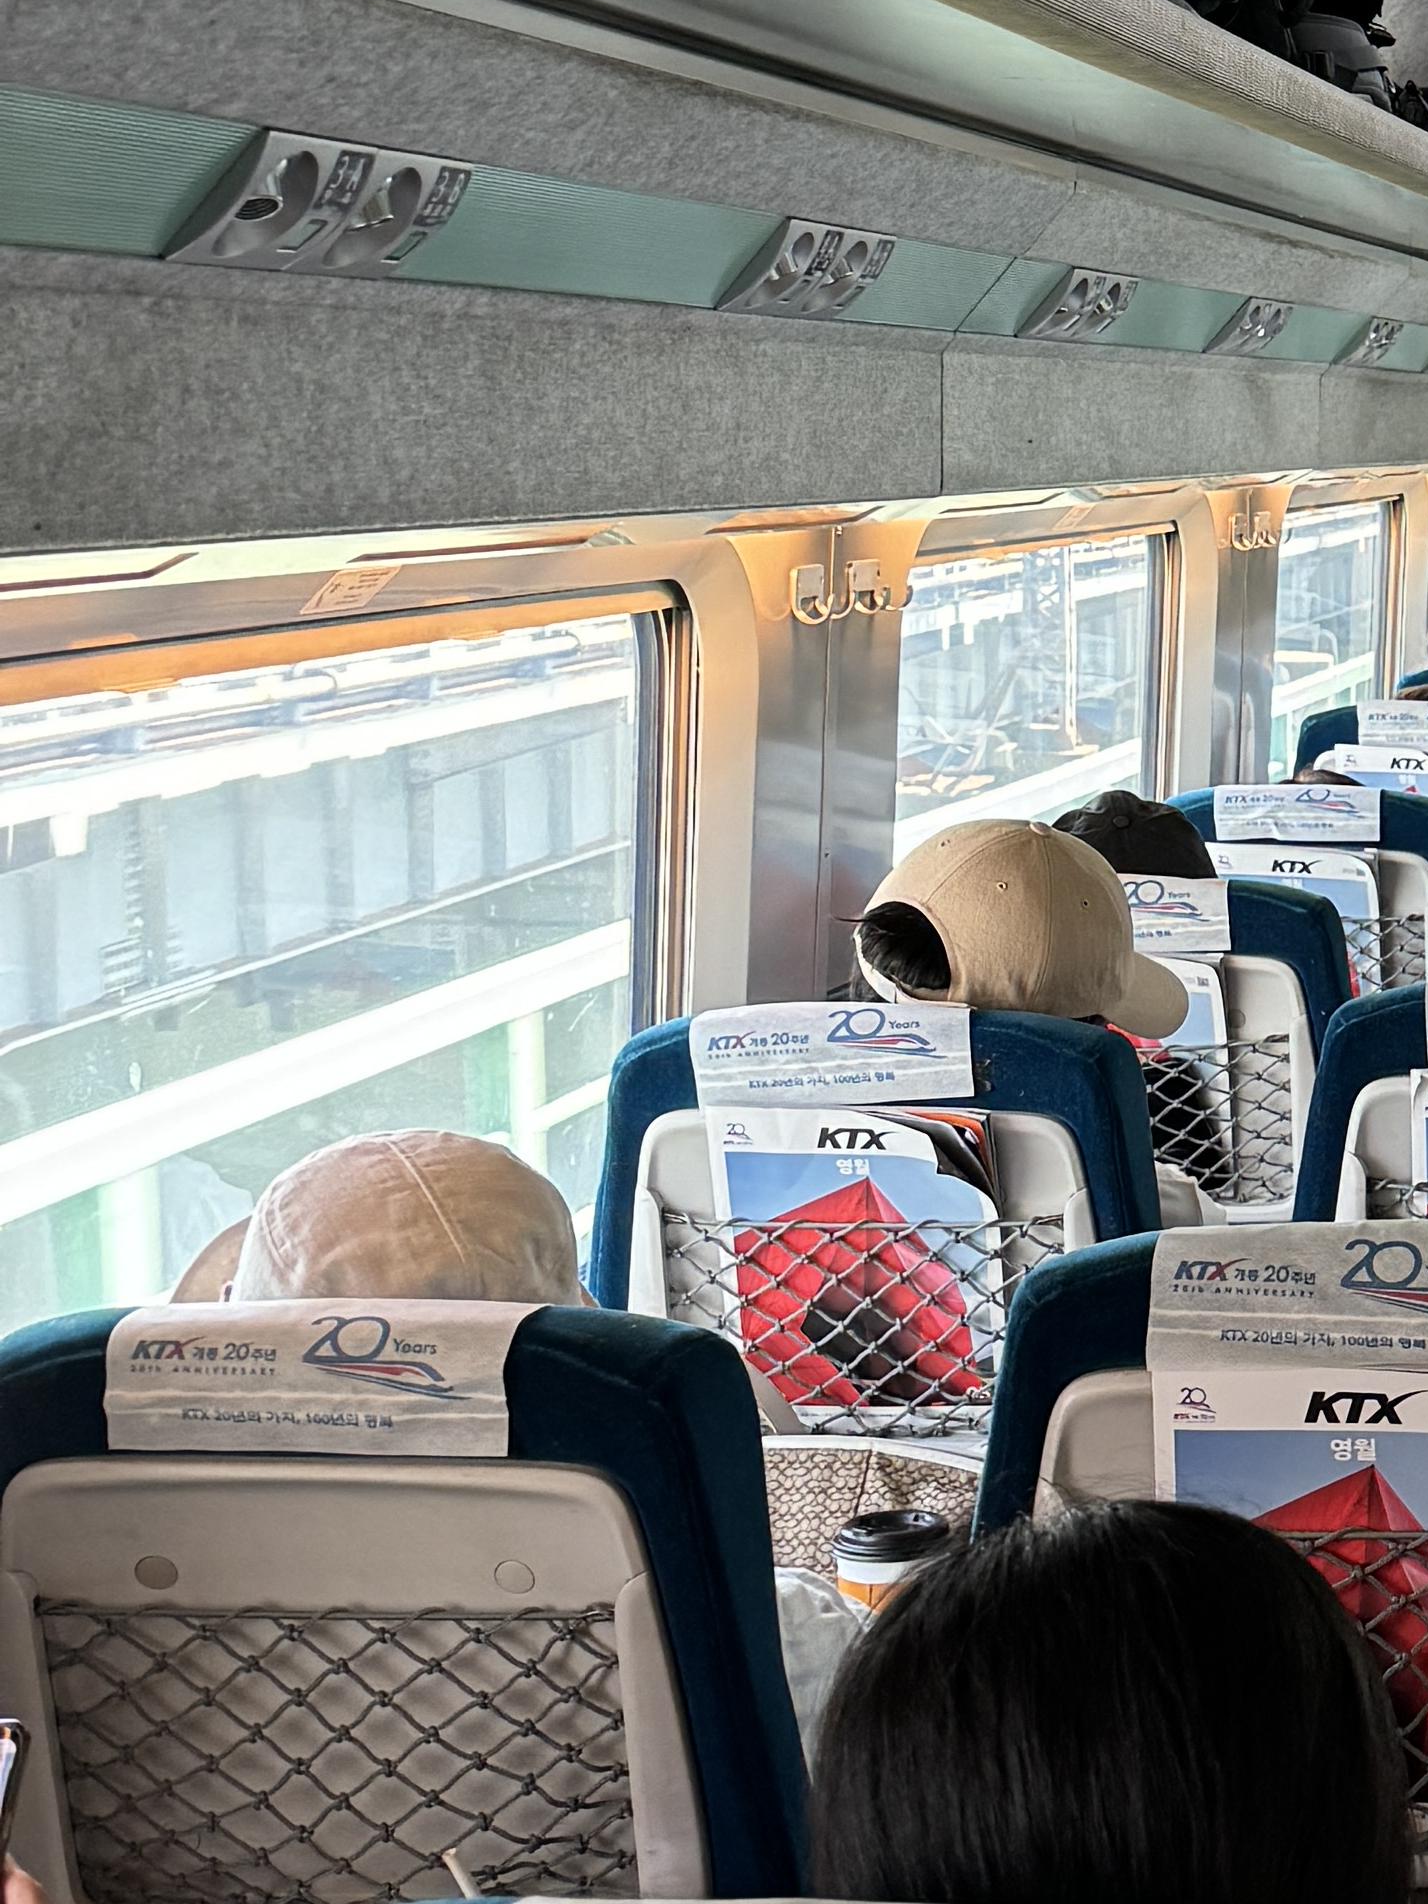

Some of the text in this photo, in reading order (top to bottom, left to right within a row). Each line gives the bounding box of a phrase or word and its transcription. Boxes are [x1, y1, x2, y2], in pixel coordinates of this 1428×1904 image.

[1390, 757, 1427, 771] KTX
[1271, 859, 1324, 875] KTX
[826, 1008, 920, 1043] 20 Years
[707, 1029, 756, 1052] KTX
[816, 1127, 899, 1151] KTX
[835, 1156, 871, 1176] 영월
[1173, 1257, 1318, 1286] KTX 20주년
[1340, 1237, 1423, 1288] 20
[131, 1336, 277, 1363] KTX 20주년
[302, 1315, 438, 1362] 20 Years
[1219, 1328, 1249, 1344] KTX
[1250, 1330, 1299, 1347] 20년의
[1339, 1332, 1395, 1349] 100년의
[181, 1408, 211, 1423] KTX
[1329, 1436, 1377, 1463] 영월
